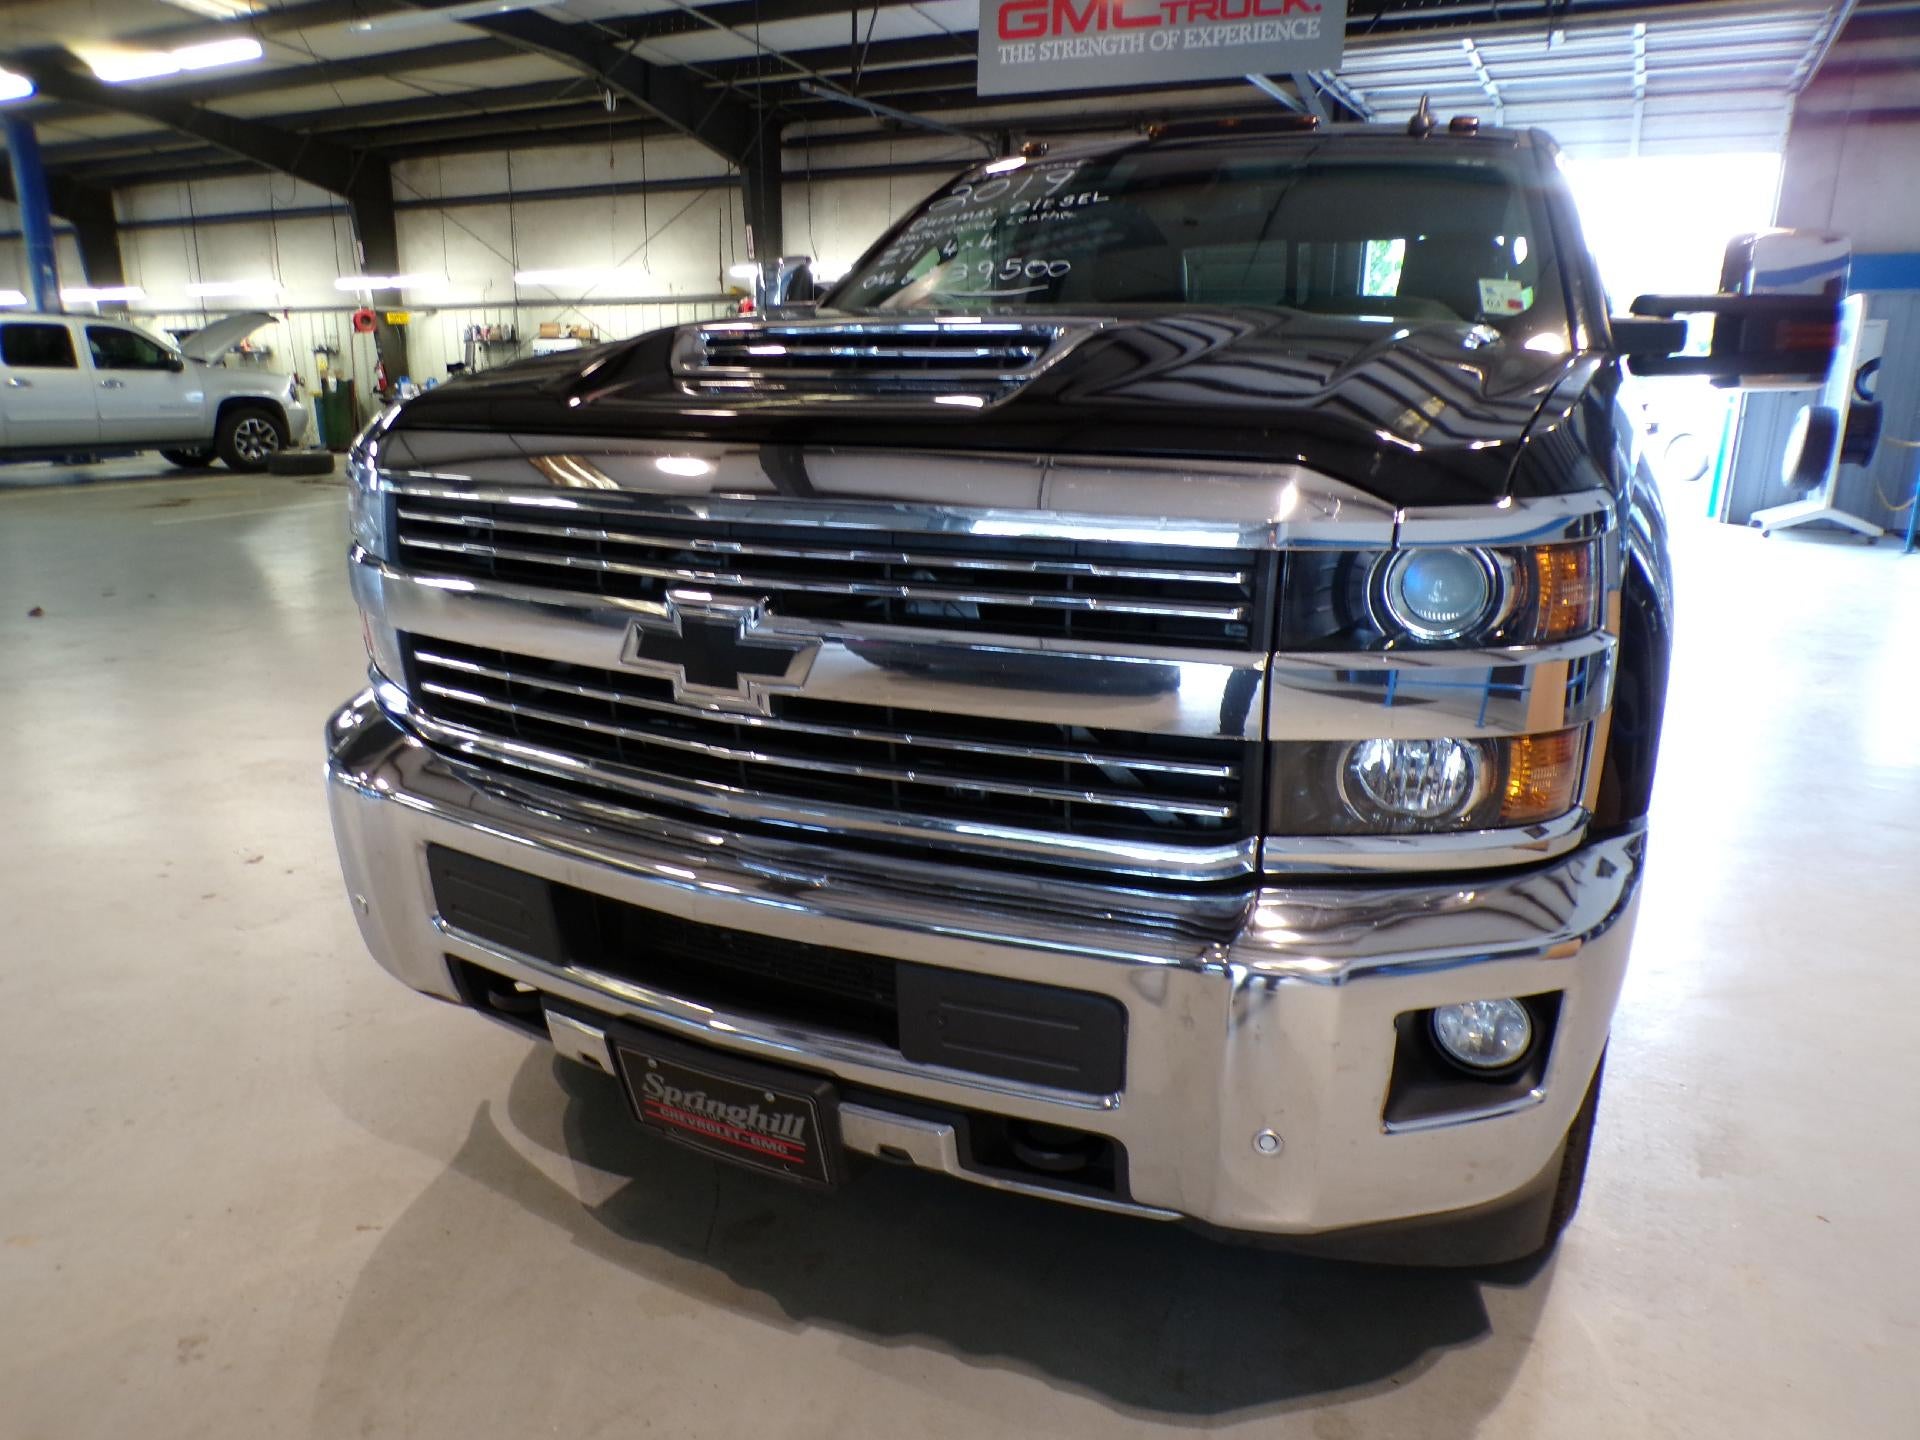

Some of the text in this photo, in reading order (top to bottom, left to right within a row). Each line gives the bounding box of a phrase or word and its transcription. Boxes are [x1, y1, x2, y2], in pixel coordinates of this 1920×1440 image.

[997, 0, 1161, 40] GMC
[998, 17, 1321, 64] THE STRENGTH OF EXPERIENCE
[928, 168, 1076, 212] 2019
[1010, 191, 1110, 215] DIESEL
[641, 1072, 806, 1140] Springhill
